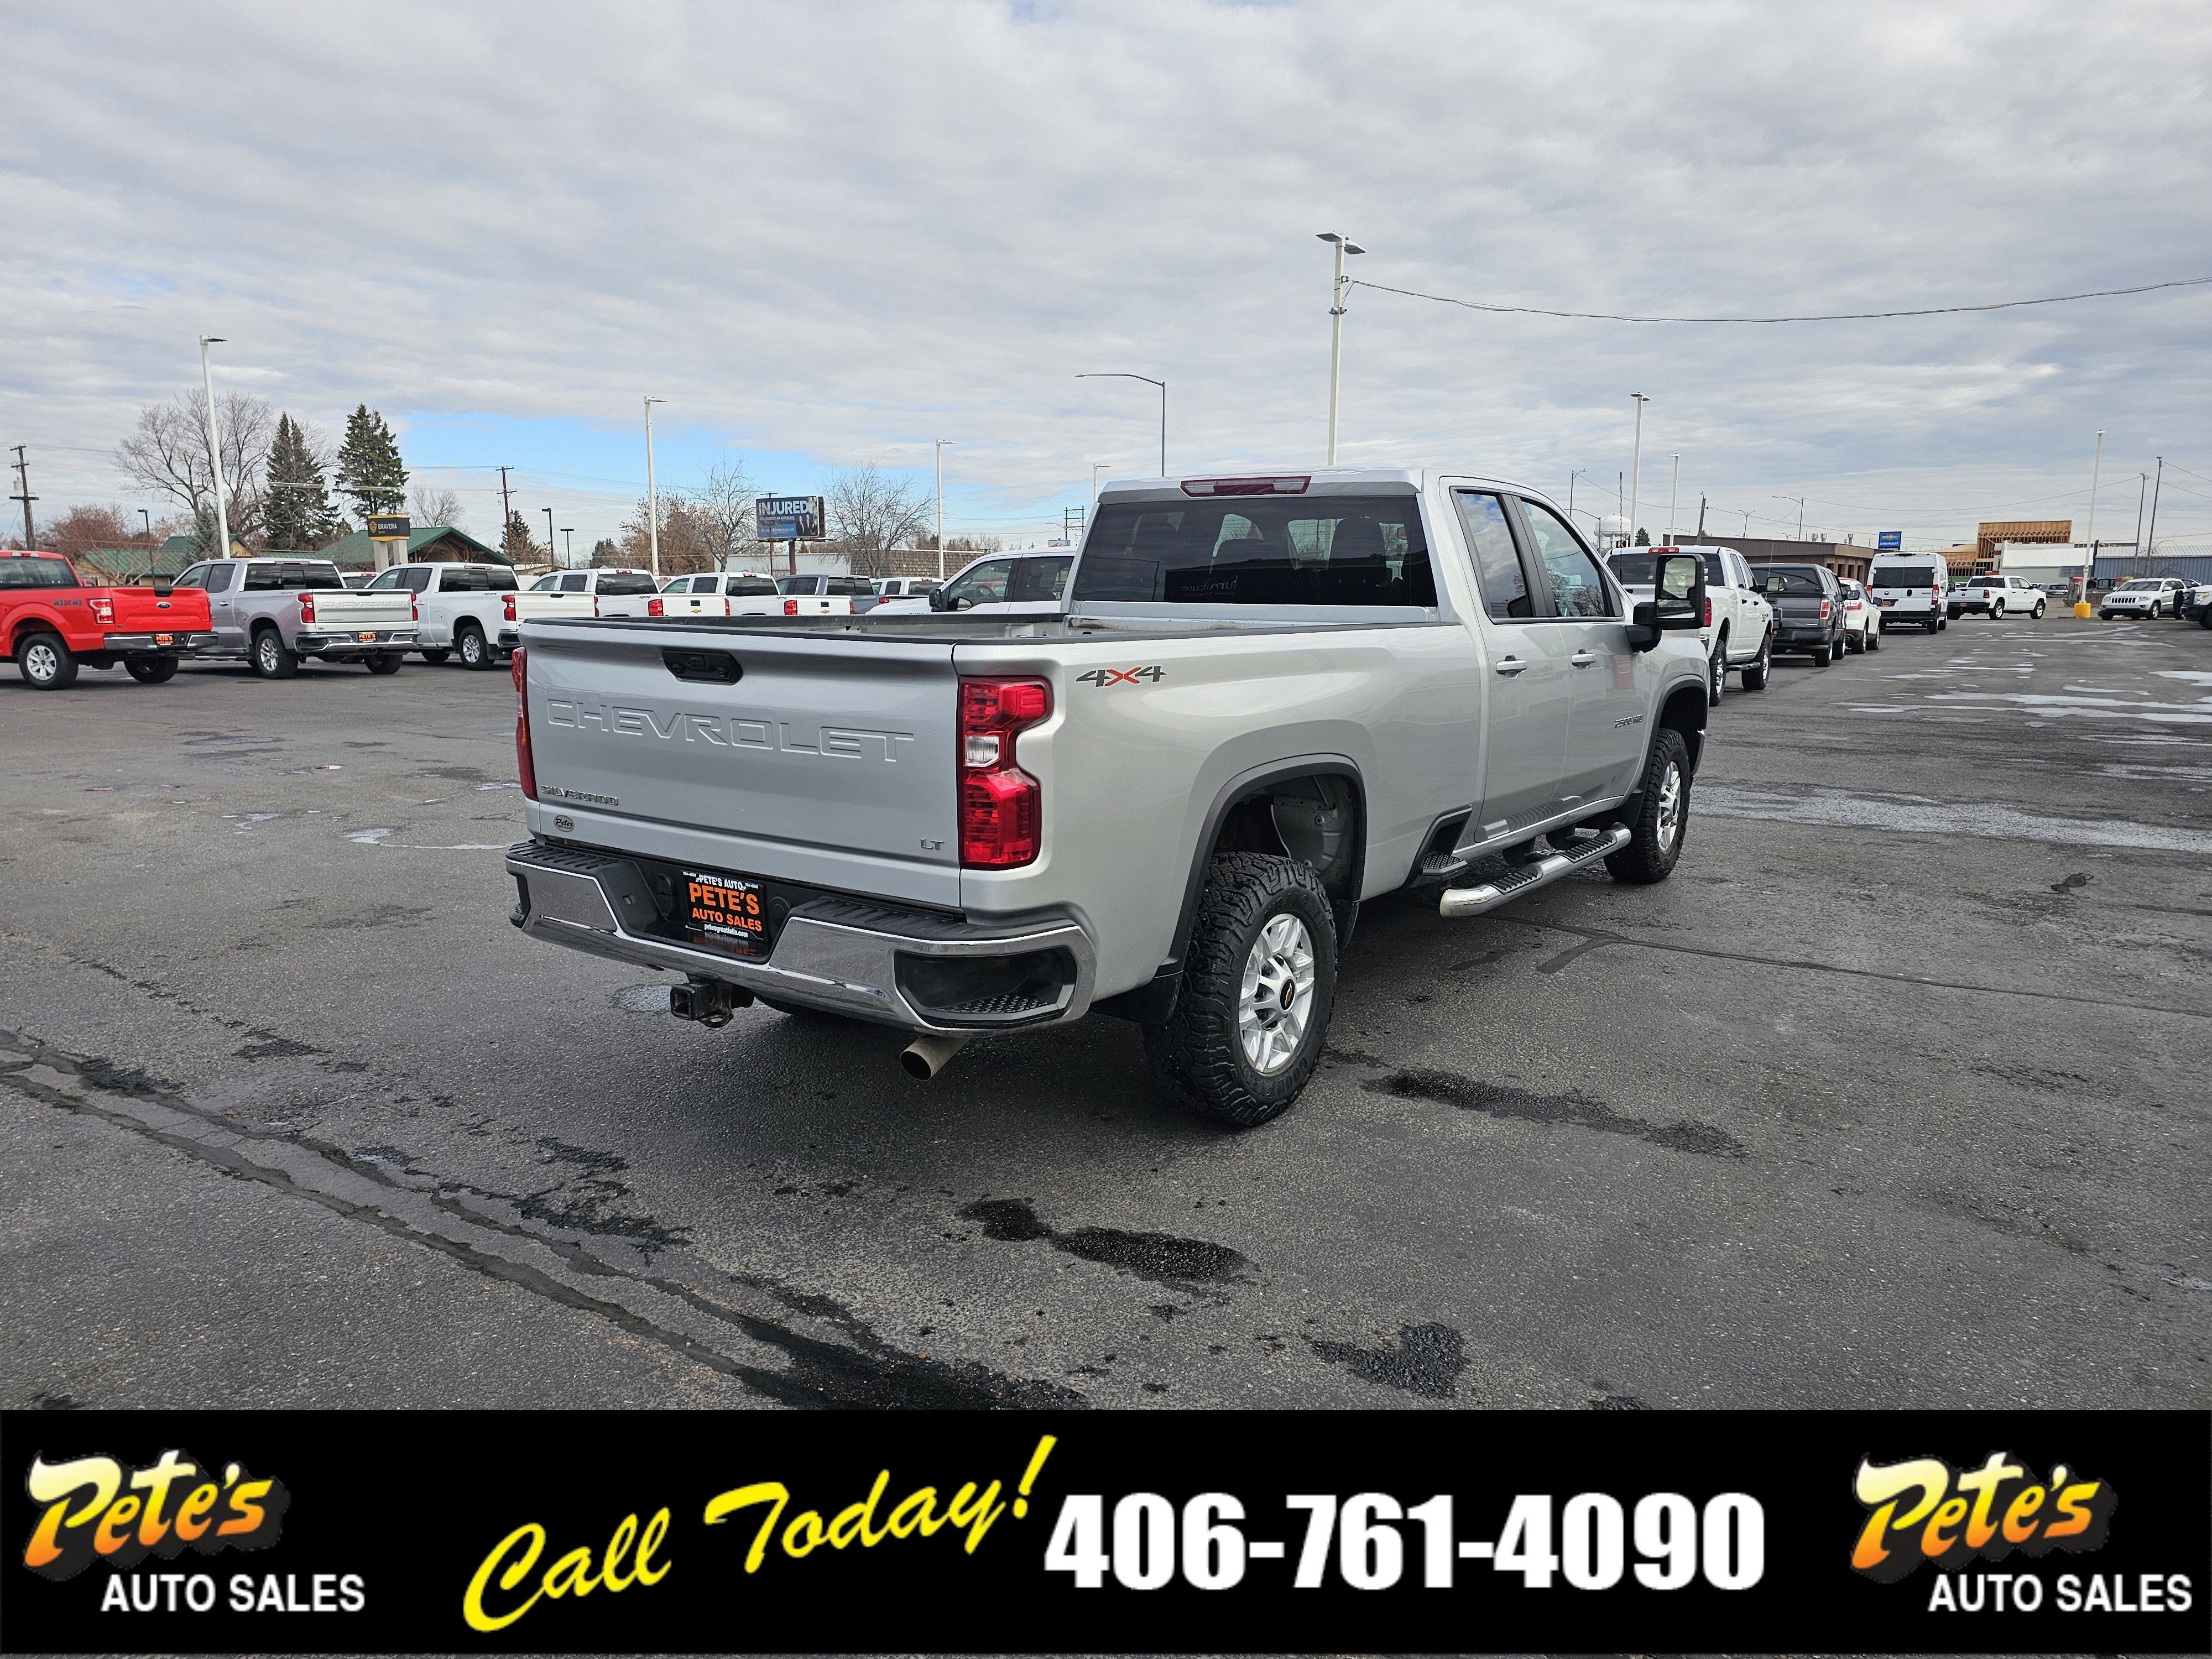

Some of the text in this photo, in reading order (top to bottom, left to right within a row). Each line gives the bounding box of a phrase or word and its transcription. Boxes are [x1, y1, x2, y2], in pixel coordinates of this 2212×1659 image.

[547, 699, 914, 762] CHEVROLET
[1615, 714, 1643, 728] 2500 HD
[541, 785, 619, 806] SILVERADO
[920, 838, 945, 851] LT
[699, 874, 723, 887] PETE'S
[724, 879, 744, 891] AUTO
[689, 883, 759, 915] PETE'S
[692, 907, 762, 931] AUTO SALES
